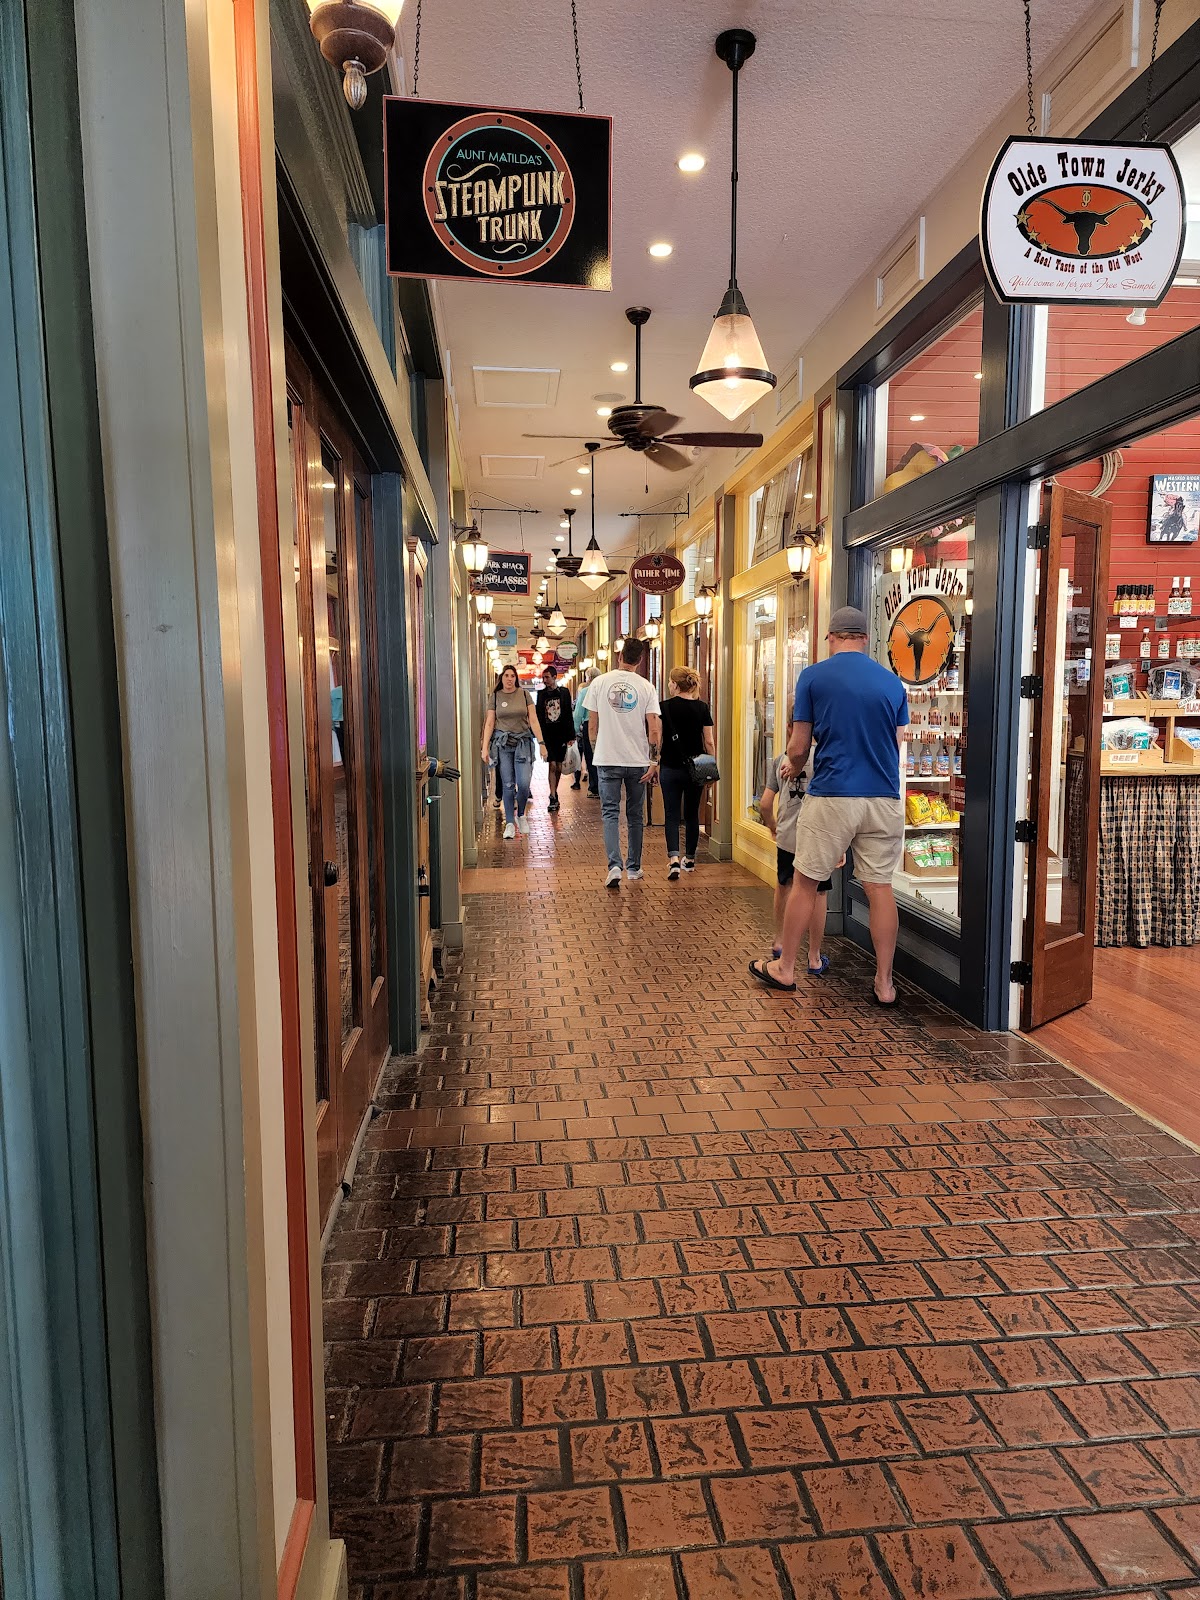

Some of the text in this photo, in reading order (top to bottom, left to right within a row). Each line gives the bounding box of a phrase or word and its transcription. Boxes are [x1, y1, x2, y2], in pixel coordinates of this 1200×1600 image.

[456, 148, 543, 166] AUNT MATILDA'S
[1007, 151, 1166, 206] Olde Town Jerky
[434, 170, 567, 223] STEAMPUNK
[476, 210, 544, 243] TRUNK
[1023, 247, 1143, 274] A Real Taste of the Old West
[1064, 276, 1077, 290] fer
[1096, 277, 1118, 291] Free
[1120, 278, 1156, 292] Sample
[1155, 478, 1200, 492] WESTERN
[501, 562, 525, 575] SHACK
[634, 567, 681, 579] FATHER TIME
[884, 583, 902, 621] Olde
[906, 563, 931, 594] Town
[1185, 702, 1200, 713] BLAC
[1111, 754, 1137, 762] BEEF
